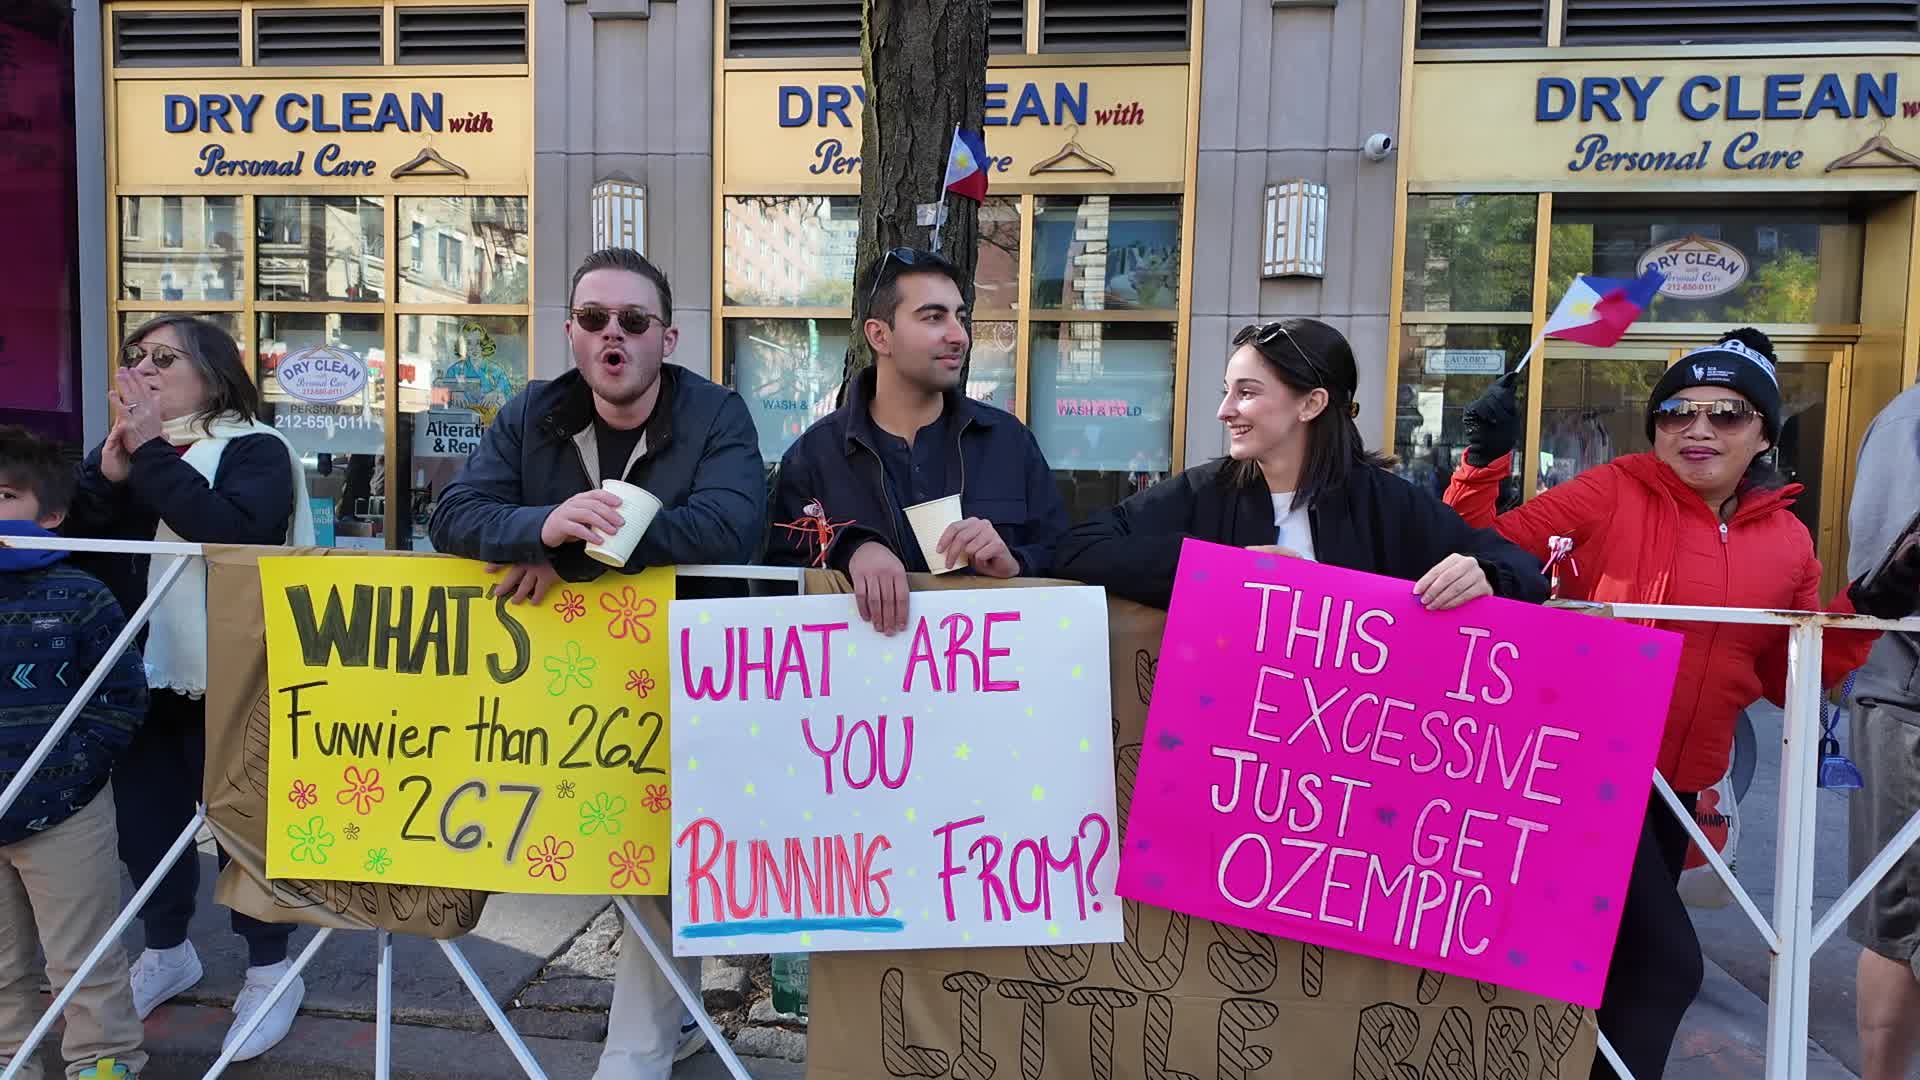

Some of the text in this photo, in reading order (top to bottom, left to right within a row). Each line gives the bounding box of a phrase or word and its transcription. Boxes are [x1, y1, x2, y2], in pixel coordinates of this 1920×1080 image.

[163, 92, 495, 134] DRY CLEAN with
[983, 82, 1088, 127] EAN
[1095, 101, 1145, 126] with
[1536, 72, 1899, 123] DRY CLEAN
[194, 143, 377, 177] Personal Care
[1568, 131, 1804, 172] Personal Care
[1685, 252, 1740, 275] CLEAN
[283, 360, 360, 380] DRY CLEAN
[275, 415, 371, 429] 212-650-0111
[425, 420, 485, 438] Alterati
[763, 400, 808, 410] WASH &
[1057, 406, 1142, 416] WASH & FOLD
[433, 438, 446, 453] &
[285, 583, 530, 683] WHAT'S
[680, 610, 1021, 701] WHAT ARE
[1243, 581, 1519, 705] THIS IS
[464, 696, 549, 766] than
[559, 704, 667, 774] 26.2
[801, 714, 914, 795] YOU
[1247, 666, 1580, 805] EXCESSIVE
[399, 775, 545, 866] 26.7
[1210, 746, 1371, 838] JUST
[1412, 799, 1549, 886] GET
[676, 812, 1111, 923] RUNNING FROM?
[1217, 832, 1492, 958] OZEMPIC
[880, 967, 1279, 1080] LITTLE
